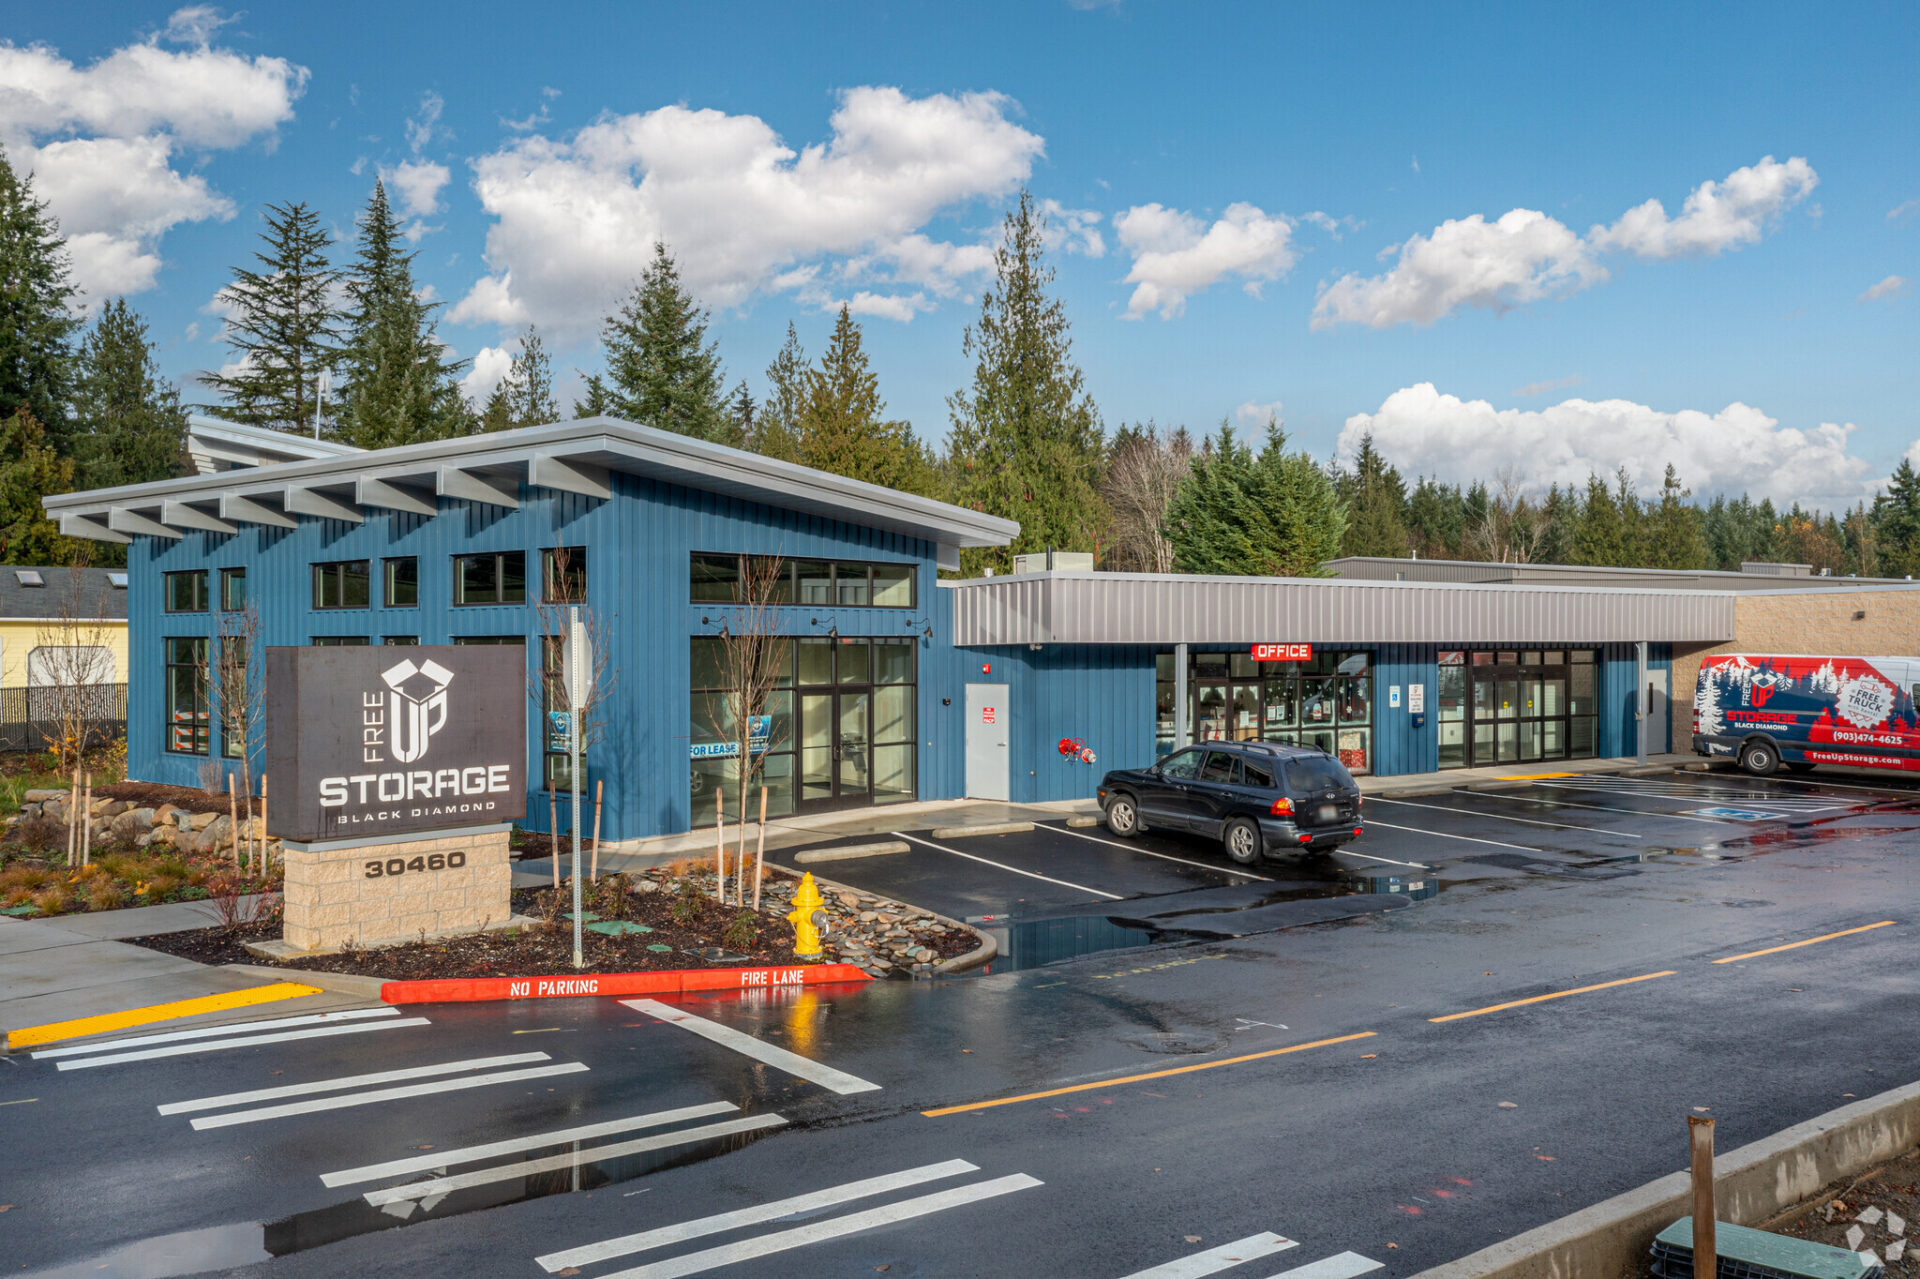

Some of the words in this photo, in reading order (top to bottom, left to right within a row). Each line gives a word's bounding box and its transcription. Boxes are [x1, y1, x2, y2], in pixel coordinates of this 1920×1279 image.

[1258, 645, 1308, 657] OFFICE
[1751, 683, 1775, 707] UP
[1849, 694, 1883, 713] TRUCK
[1856, 689, 1880, 703] FREE
[391, 689, 447, 763] UP
[1726, 711, 1798, 724] STORAGE
[363, 691, 384, 763] FREE
[709, 745, 736, 755] LEASE
[1812, 752, 1901, 764] FreeUpStorage.com
[319, 764, 510, 807] STORAGE
[337, 811, 401, 824] BLACK
[411, 802, 496, 817] DIAMOND
[365, 852, 466, 879] 30460
[741, 972, 768, 985] FIRE
[773, 970, 804, 984] LANE
[510, 981, 530, 996] NO
[538, 979, 598, 995] PARKING
